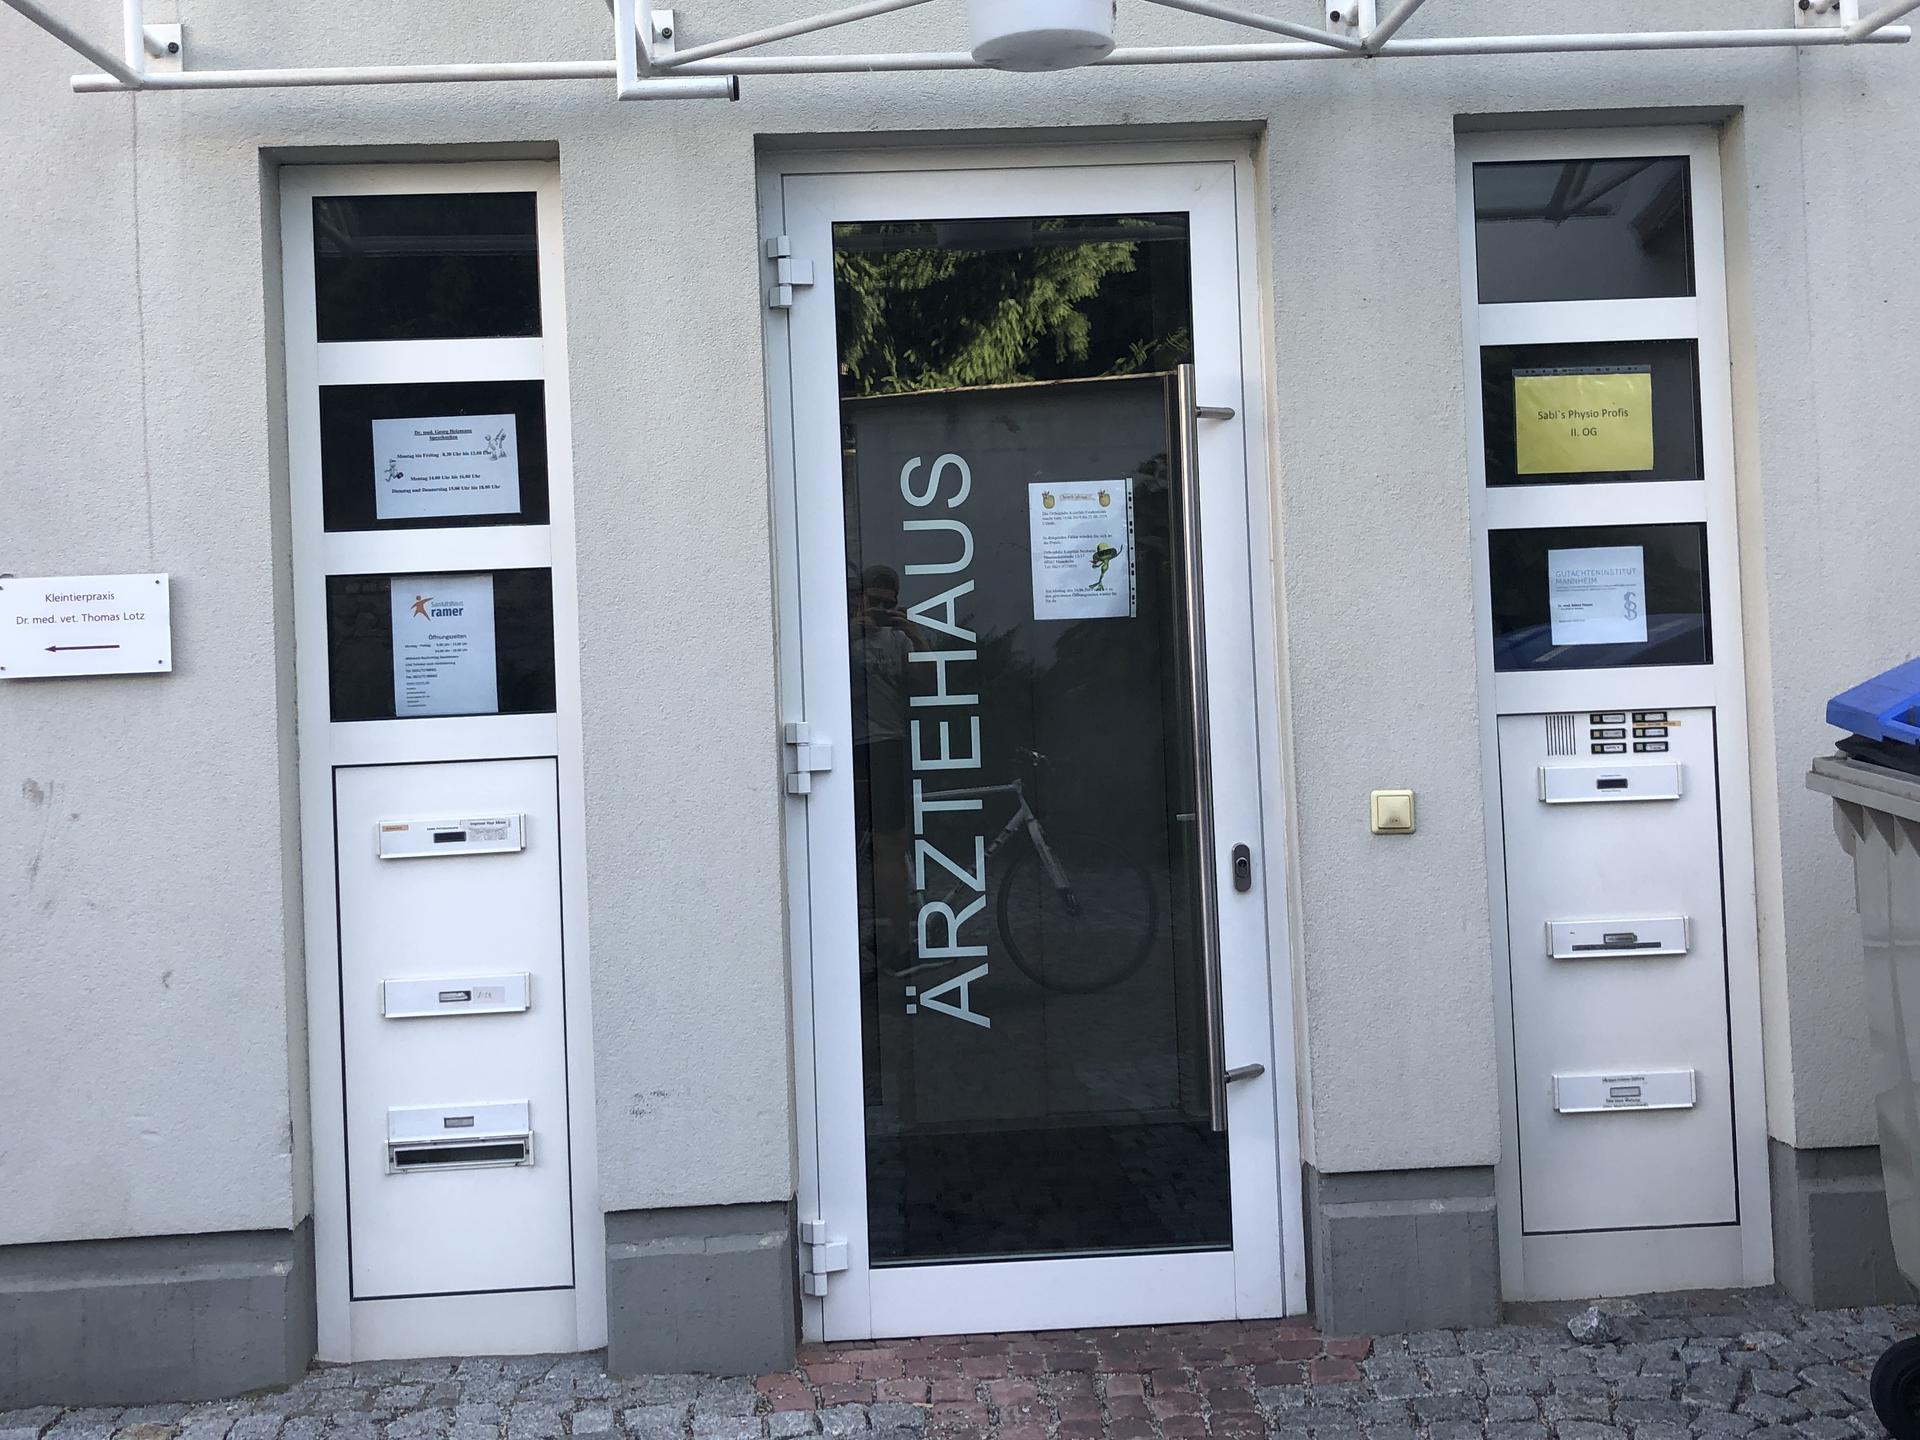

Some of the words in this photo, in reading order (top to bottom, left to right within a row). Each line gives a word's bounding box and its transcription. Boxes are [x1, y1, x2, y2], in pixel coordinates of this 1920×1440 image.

[1568, 409, 1599, 421] Physio
[1601, 407, 1629, 419] Profis
[1570, 428, 1580, 438] II.
[1582, 427, 1598, 437] OG
[1555, 567, 1637, 578] GUTACHTENINSTITUT
[1555, 577, 1598, 586] MANNHEIM
[45, 591, 115, 603] Kleintierpraxis
[16, 616, 30, 625] Dr.
[32, 615, 57, 624] med.
[60, 615, 79, 624] vet.
[81, 613, 120, 623] Thomas
[123, 611, 145, 621] Lotz
[431, 607, 464, 618] ramer
[899, 452, 992, 1030] ÄRZTEHAUS
